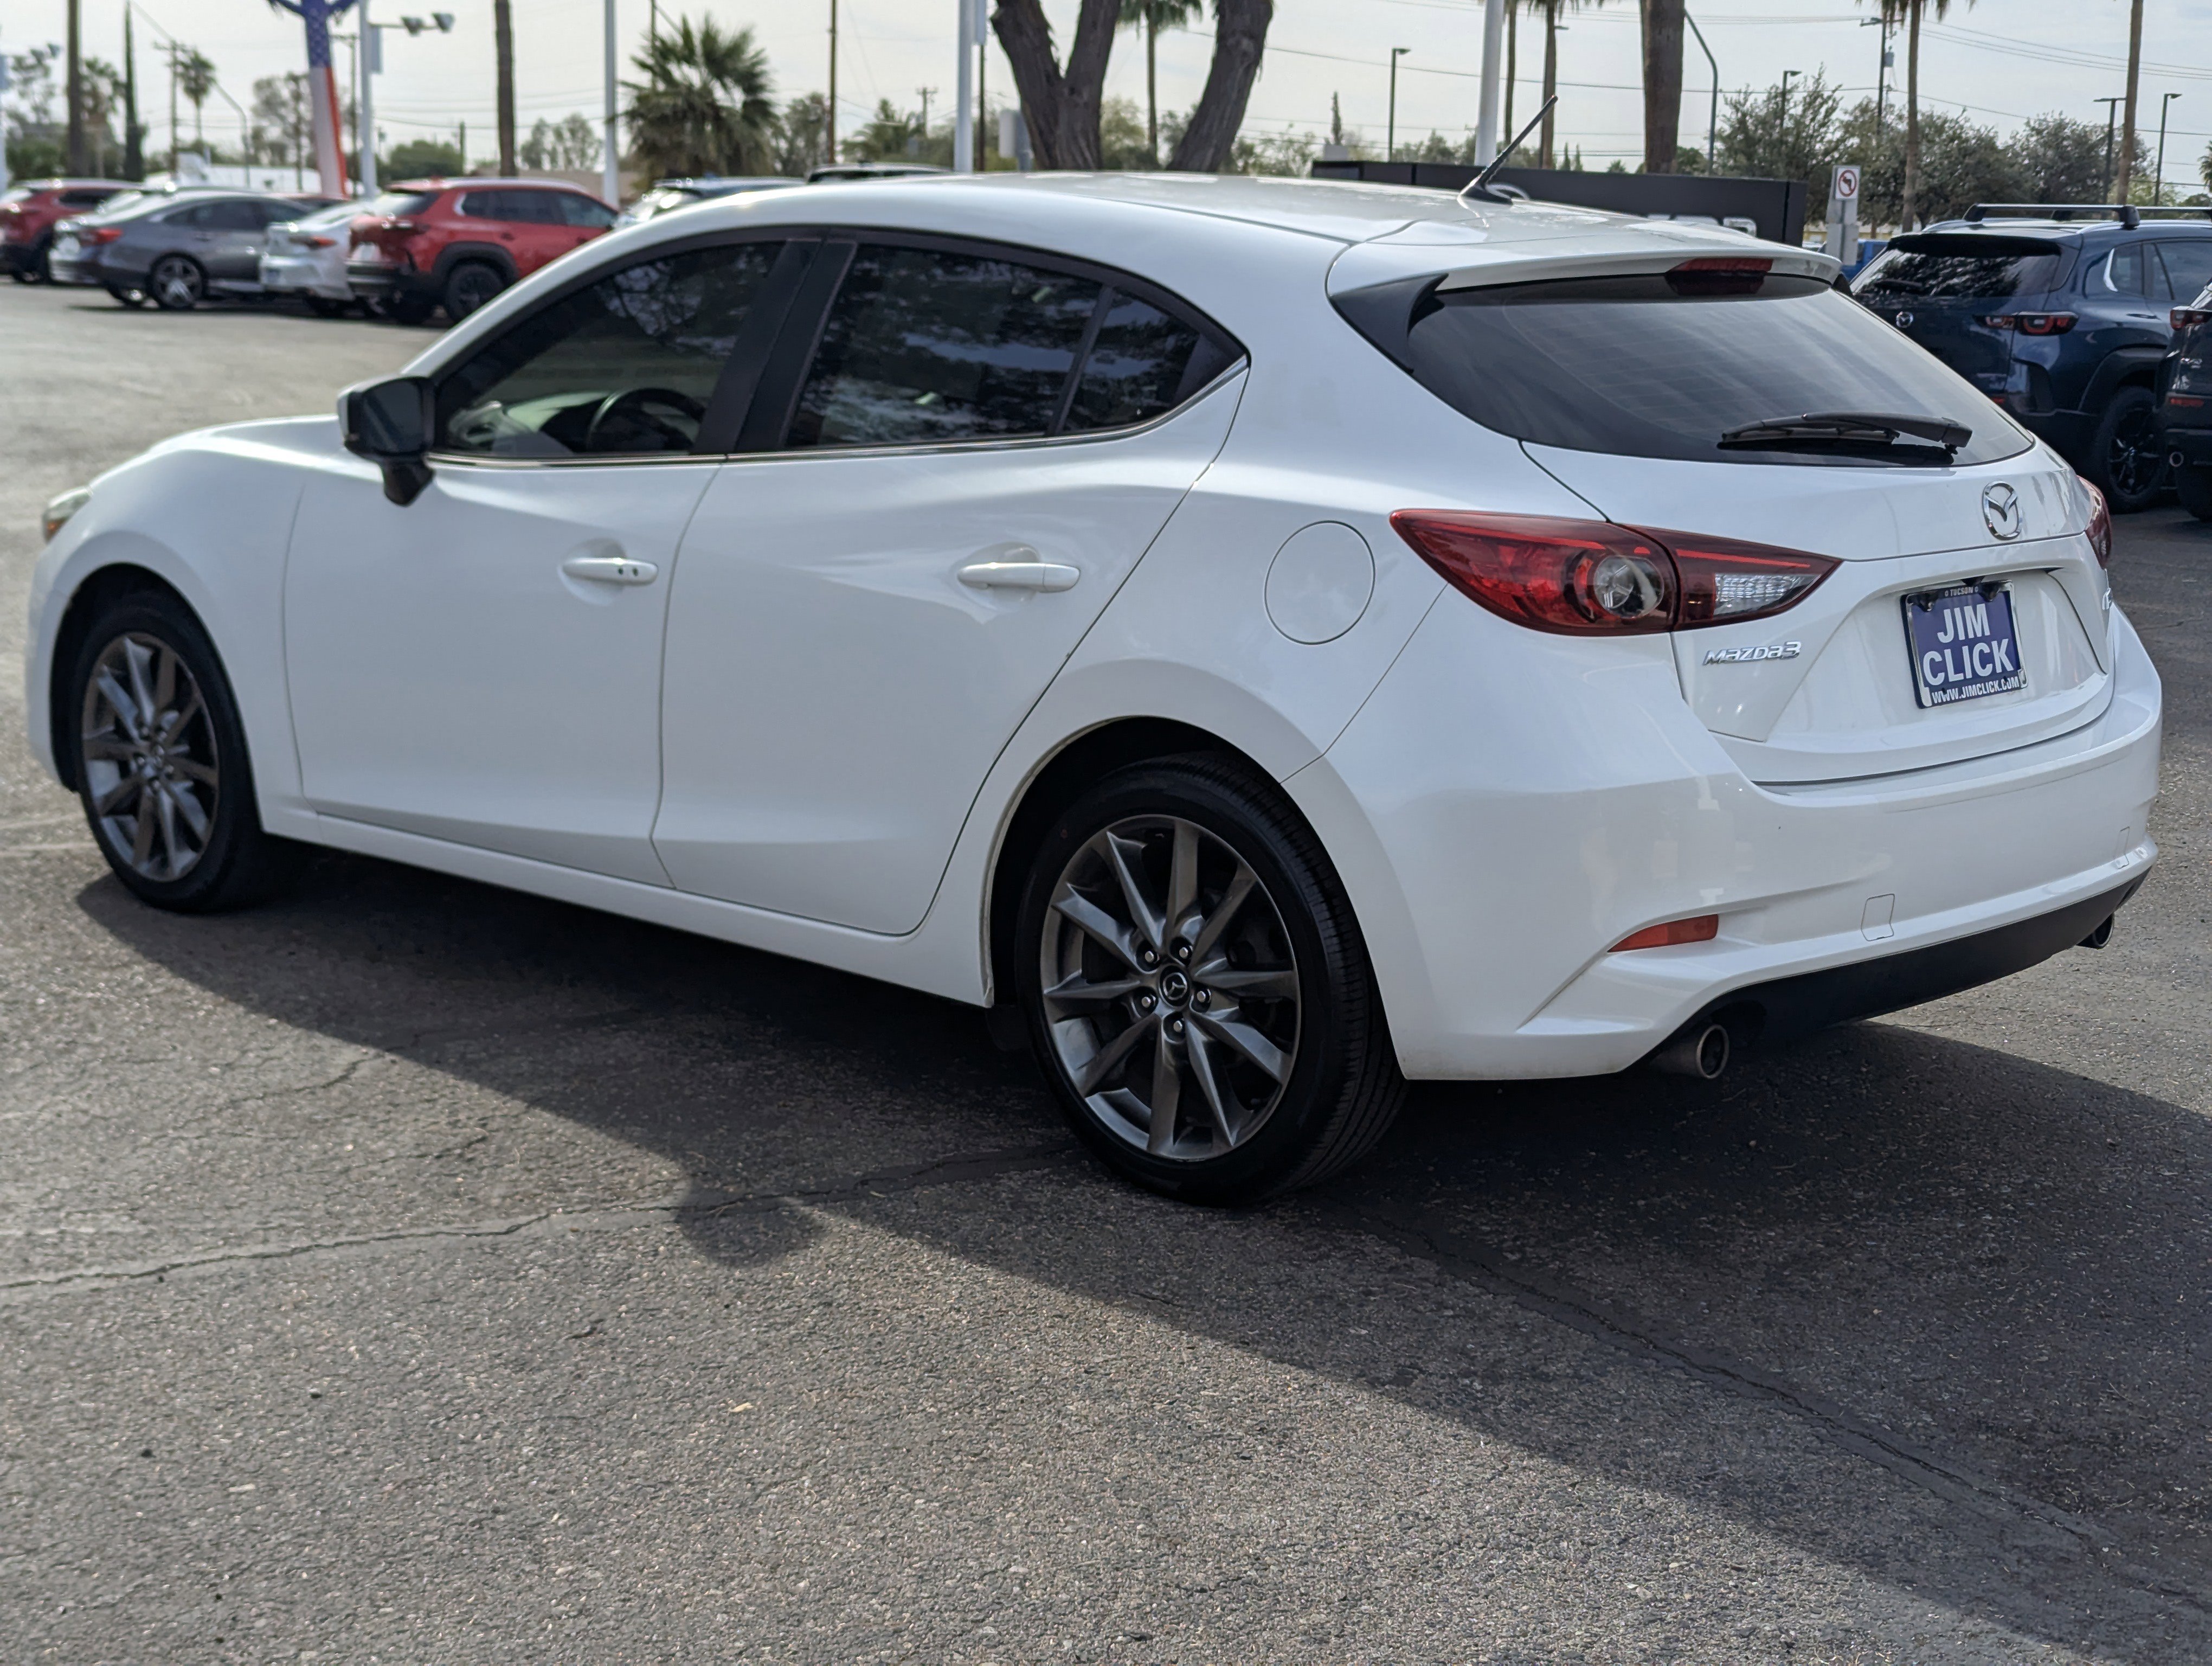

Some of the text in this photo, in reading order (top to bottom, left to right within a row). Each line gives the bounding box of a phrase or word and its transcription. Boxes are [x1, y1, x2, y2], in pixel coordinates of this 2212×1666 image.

[1950, 587, 1973, 596] TUCSON
[1937, 603, 1990, 643] JIM
[1923, 638, 2014, 685] CLICK
[1932, 676, 2019, 704] WWW.JIMCLICK.COM
